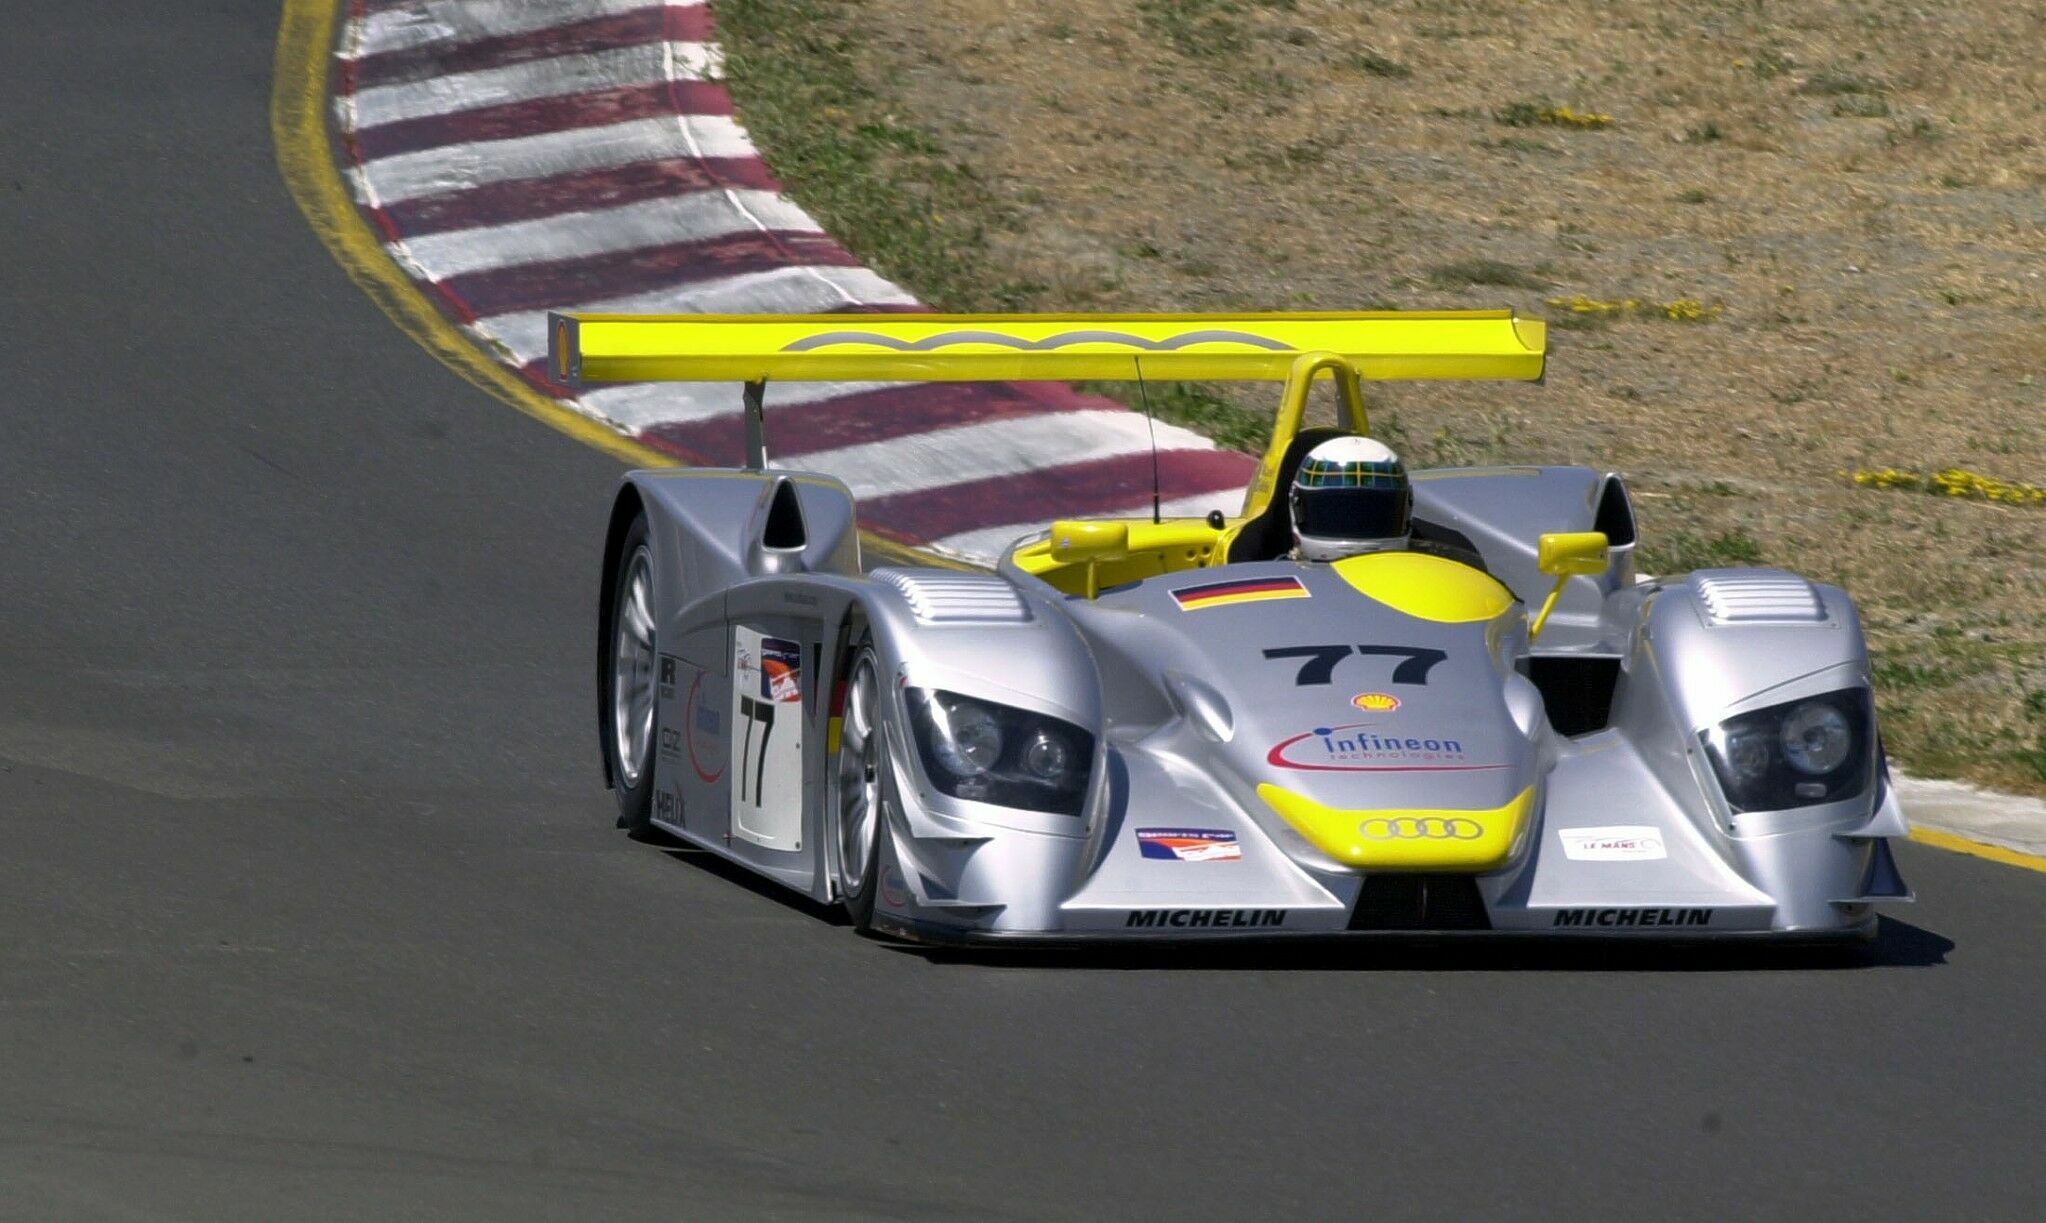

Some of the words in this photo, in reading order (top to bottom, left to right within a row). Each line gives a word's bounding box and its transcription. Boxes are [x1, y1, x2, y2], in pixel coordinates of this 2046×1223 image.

[1262, 644, 1448, 687] 77
[740, 694, 775, 808] 77
[1126, 909, 1287, 928] MICHELIN
[1553, 908, 1713, 926] MICHELIN
